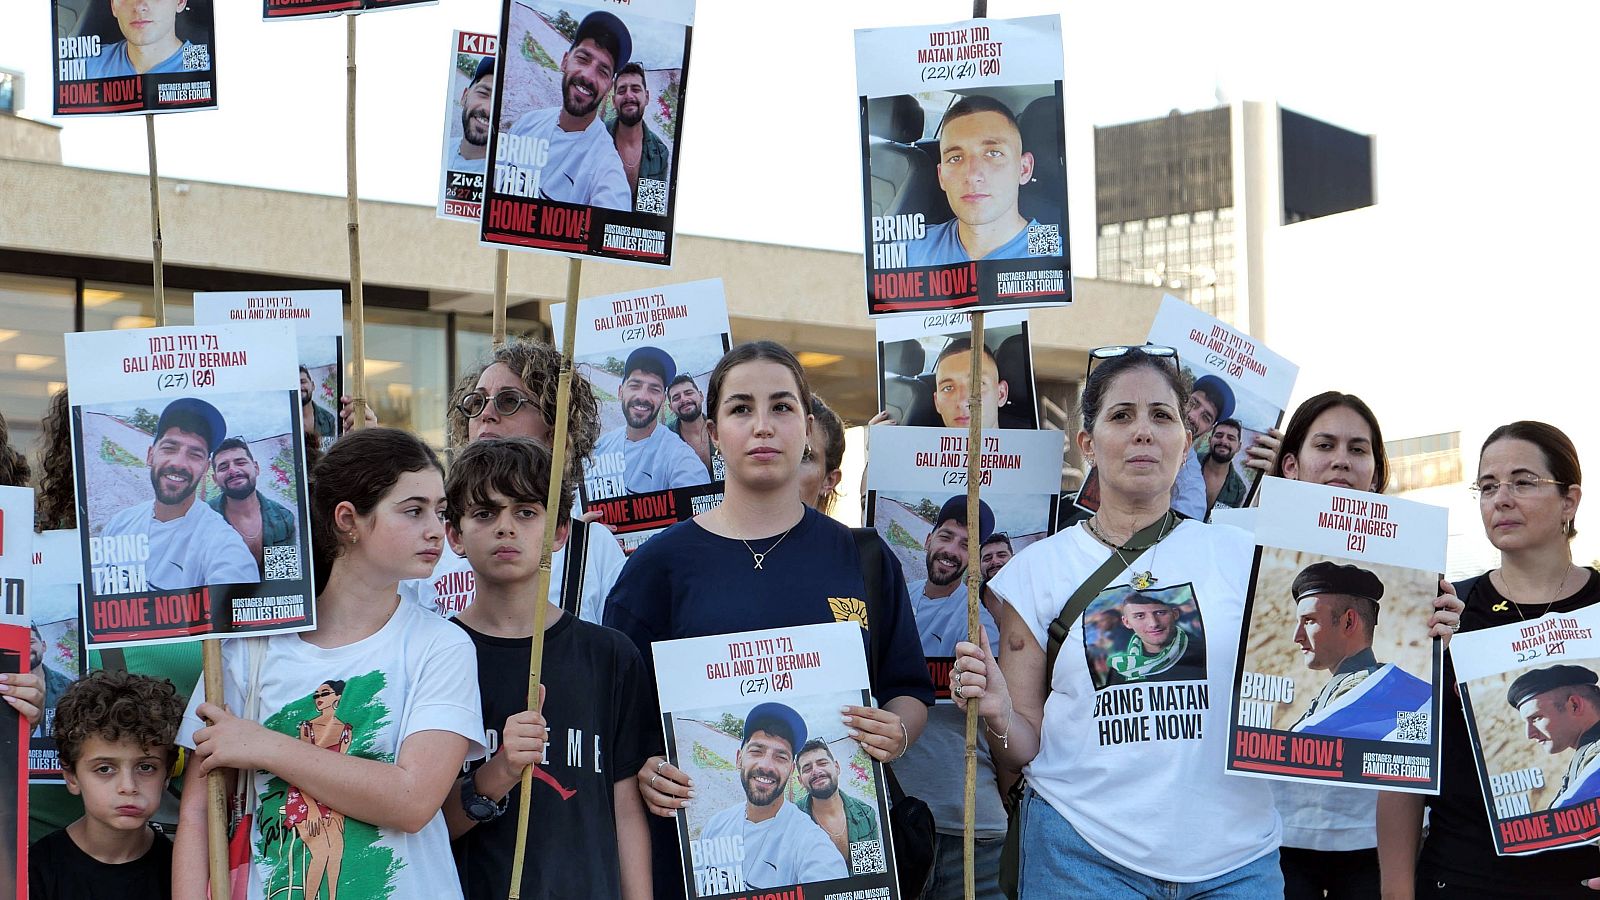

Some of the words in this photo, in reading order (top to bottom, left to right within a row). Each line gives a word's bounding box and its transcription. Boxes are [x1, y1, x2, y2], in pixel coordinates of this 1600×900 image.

[930, 30, 968, 46] אנגרסט
[971, 26, 990, 44] מתן
[58, 35, 101, 59] BRING
[918, 48, 953, 63] MATAN
[957, 43, 1002, 61] ANGREST
[59, 57, 87, 81] HIM
[60, 82, 99, 105] HOME
[103, 76, 143, 102] NOW!
[158, 92, 188, 102] FAMILIES
[190, 89, 211, 100] FORUM
[496, 132, 549, 168] BRING
[494, 162, 540, 199] THEM
[490, 199, 536, 234] HOME
[540, 204, 592, 241] NOW!
[872, 213, 925, 242] BRING
[604, 223, 631, 238] HOSTAGES
[631, 228, 643, 239] AND
[643, 229, 666, 241] MISSING
[602, 232, 637, 254] FAMILIES
[637, 238, 665, 257] FORUM
[873, 243, 908, 269] HIM
[874, 271, 924, 300] HOME
[929, 263, 977, 296] NOW!
[997, 272, 1026, 283] HOSTAGES
[1026, 272, 1038, 281] AND
[1038, 270, 1063, 281] MISSING
[997, 280, 1035, 296] FAMILIES
[1035, 278, 1063, 294] FORUM
[247, 297, 264, 309] ברמן
[281, 296, 293, 308] גלי
[612, 299, 632, 315] ברמן
[633, 296, 649, 311] וזיו
[651, 293, 665, 307] גלי
[230, 309, 246, 320] GALI
[249, 309, 263, 319] AND
[265, 309, 278, 319] ZIV
[279, 308, 310, 319] BERMAN
[594, 316, 615, 331] GALI
[616, 313, 634, 328] AND
[635, 310, 649, 325] ZIV
[650, 304, 688, 322] BERMAN
[178, 335, 198, 351] וזיו
[201, 334, 219, 351] גלי
[621, 326, 645, 344] (27)
[1210, 324, 1229, 343] ברמן
[149, 336, 174, 355] ברמן
[1189, 328, 1208, 346] GALI
[1207, 338, 1225, 354] AND
[1224, 345, 1238, 360] ZIV
[1237, 352, 1268, 377] BERMAN
[1244, 341, 1255, 356] גלי
[123, 356, 149, 373] GALI
[152, 353, 175, 371] AND
[177, 352, 196, 369] ZIV
[199, 350, 247, 368] BERMAN
[1205, 352, 1227, 371] (27)
[158, 371, 189, 391] (27)
[940, 436, 962, 453] ברמן
[984, 436, 999, 453] גלי
[915, 452, 938, 468] GALI
[939, 453, 960, 469] AND
[980, 453, 1021, 472] BERMAN
[584, 475, 628, 502] THEM
[631, 491, 677, 521] NOW!
[1331, 495, 1368, 517] אנגרסט
[1370, 502, 1388, 520] מתן
[1318, 512, 1352, 532] MATAN
[1353, 517, 1398, 539] ANGREST
[89, 533, 149, 565] BRING
[1347, 533, 1366, 553] (21)
[92, 563, 150, 596] THEM
[93, 598, 149, 630] HOME
[153, 588, 211, 626] NOW!
[232, 598, 262, 609] HOSTAGES
[262, 596, 274, 608] AND
[275, 595, 303, 607] MISSING
[232, 607, 271, 624] FAMILIES
[272, 603, 304, 621] FORUM
[755, 639, 775, 656] וזיו
[776, 636, 794, 655] גלי
[1511, 634, 1546, 652] MATAN
[1548, 628, 1592, 642] ANGREST
[728, 642, 754, 661] ברמן
[1517, 649, 1541, 663] 22
[706, 662, 731, 680] GALI
[733, 659, 755, 677] AND
[756, 656, 774, 674] ZIV
[776, 651, 821, 672] BERMAN
[741, 677, 769, 697] (27)
[1241, 671, 1295, 705] BRING
[1093, 687, 1143, 718] BRING
[1149, 684, 1209, 713] MATAN
[1237, 701, 1275, 730] HIM
[1098, 715, 1151, 746] HOME
[1156, 713, 1203, 742] NOW!
[1235, 731, 1286, 762] HOME
[1290, 738, 1344, 768] NOW!
[1362, 761, 1400, 777] FAMILIES
[1400, 766, 1430, 780] FORUM
[1363, 752, 1391, 766] HOSTAGES
[1391, 755, 1404, 767] AND
[1404, 757, 1430, 770] MISSING
[1489, 767, 1544, 797] BRING
[1494, 793, 1531, 820] HIM
[1500, 815, 1552, 844] HOME
[690, 834, 744, 868] BRING
[694, 864, 746, 897] THEM
[865, 887, 890, 898] MISSING
